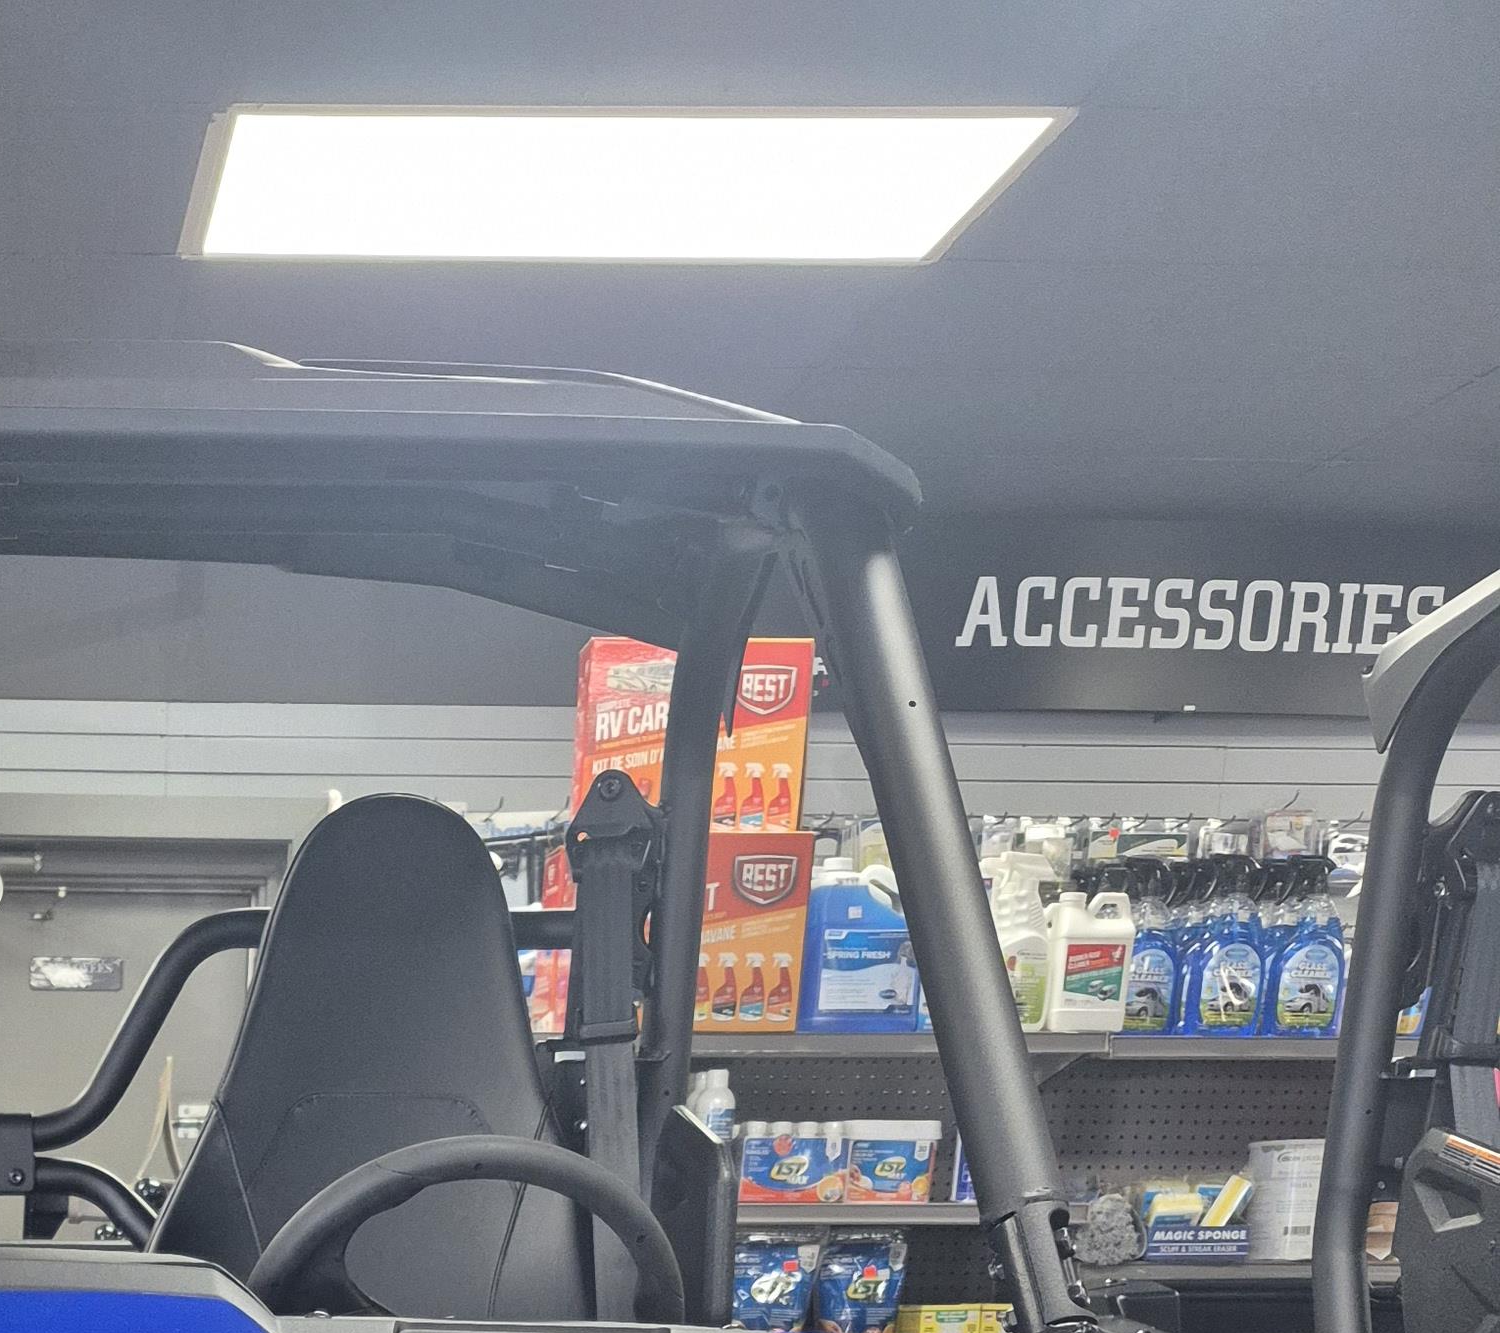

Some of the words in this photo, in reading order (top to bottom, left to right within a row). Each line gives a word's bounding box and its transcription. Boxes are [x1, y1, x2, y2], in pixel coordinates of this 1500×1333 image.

[741, 673, 788, 702] BEST
[596, 711, 624, 741] RV
[742, 863, 789, 891] BEST
[1152, 1230, 1196, 1241] MAGIC
[1197, 1230, 1247, 1240] SPONGE
